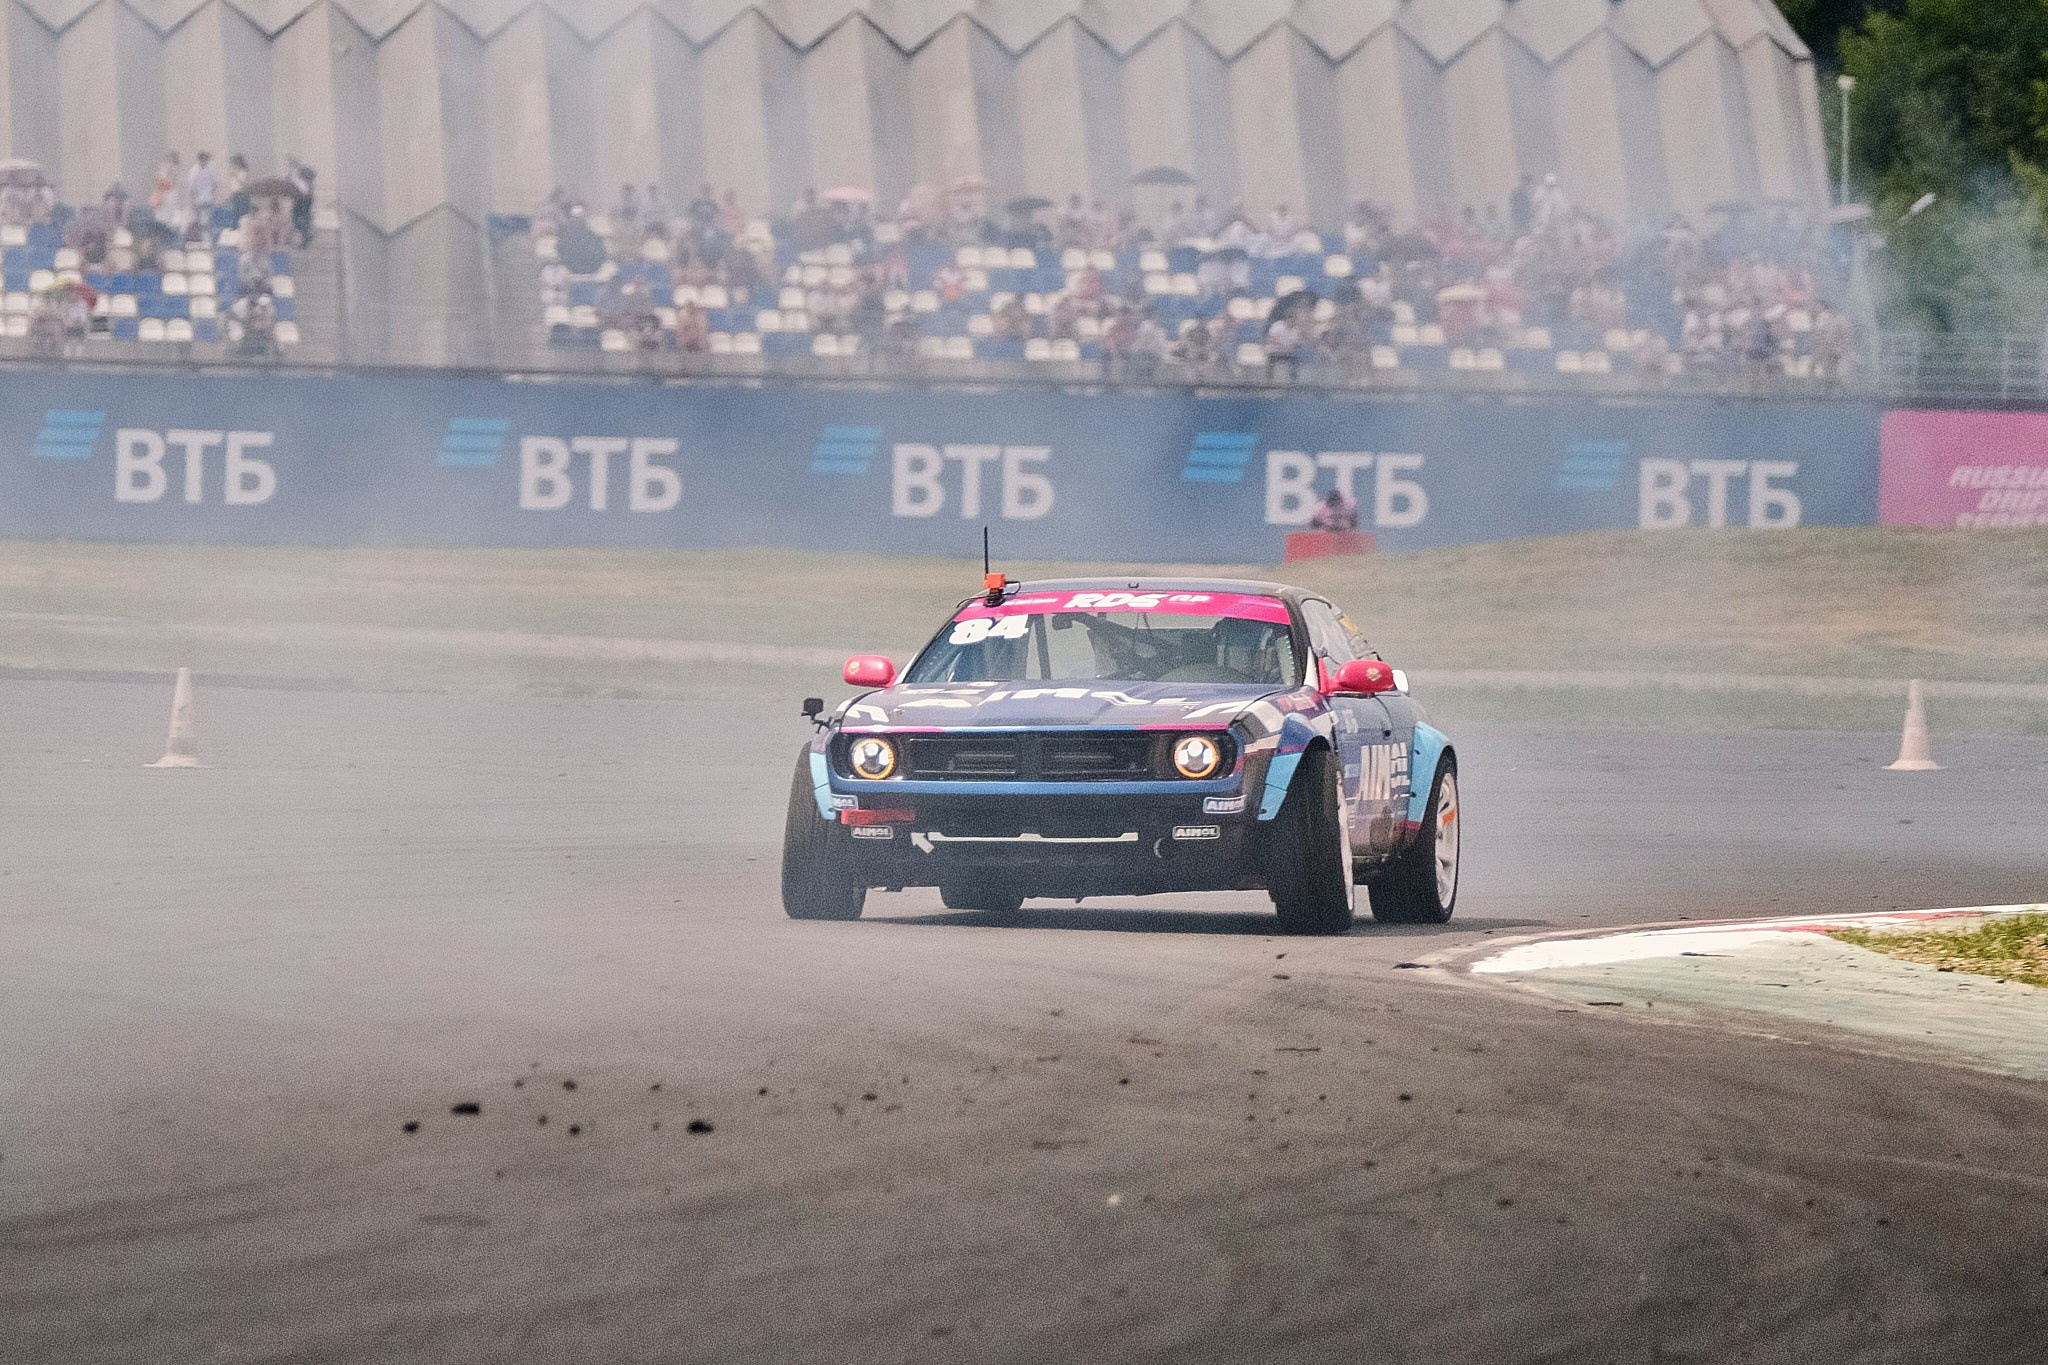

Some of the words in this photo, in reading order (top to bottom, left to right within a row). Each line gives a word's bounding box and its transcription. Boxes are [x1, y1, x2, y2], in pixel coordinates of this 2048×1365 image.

[115, 428, 277, 505] ВТБ
[519, 435, 683, 513] ВТБ
[892, 443, 1056, 520] ВТБ
[1264, 450, 1429, 527] ВТБ
[1639, 457, 1801, 530] ВТБ
[948, 613, 1030, 645] 84
[1063, 593, 1171, 608] RDS
